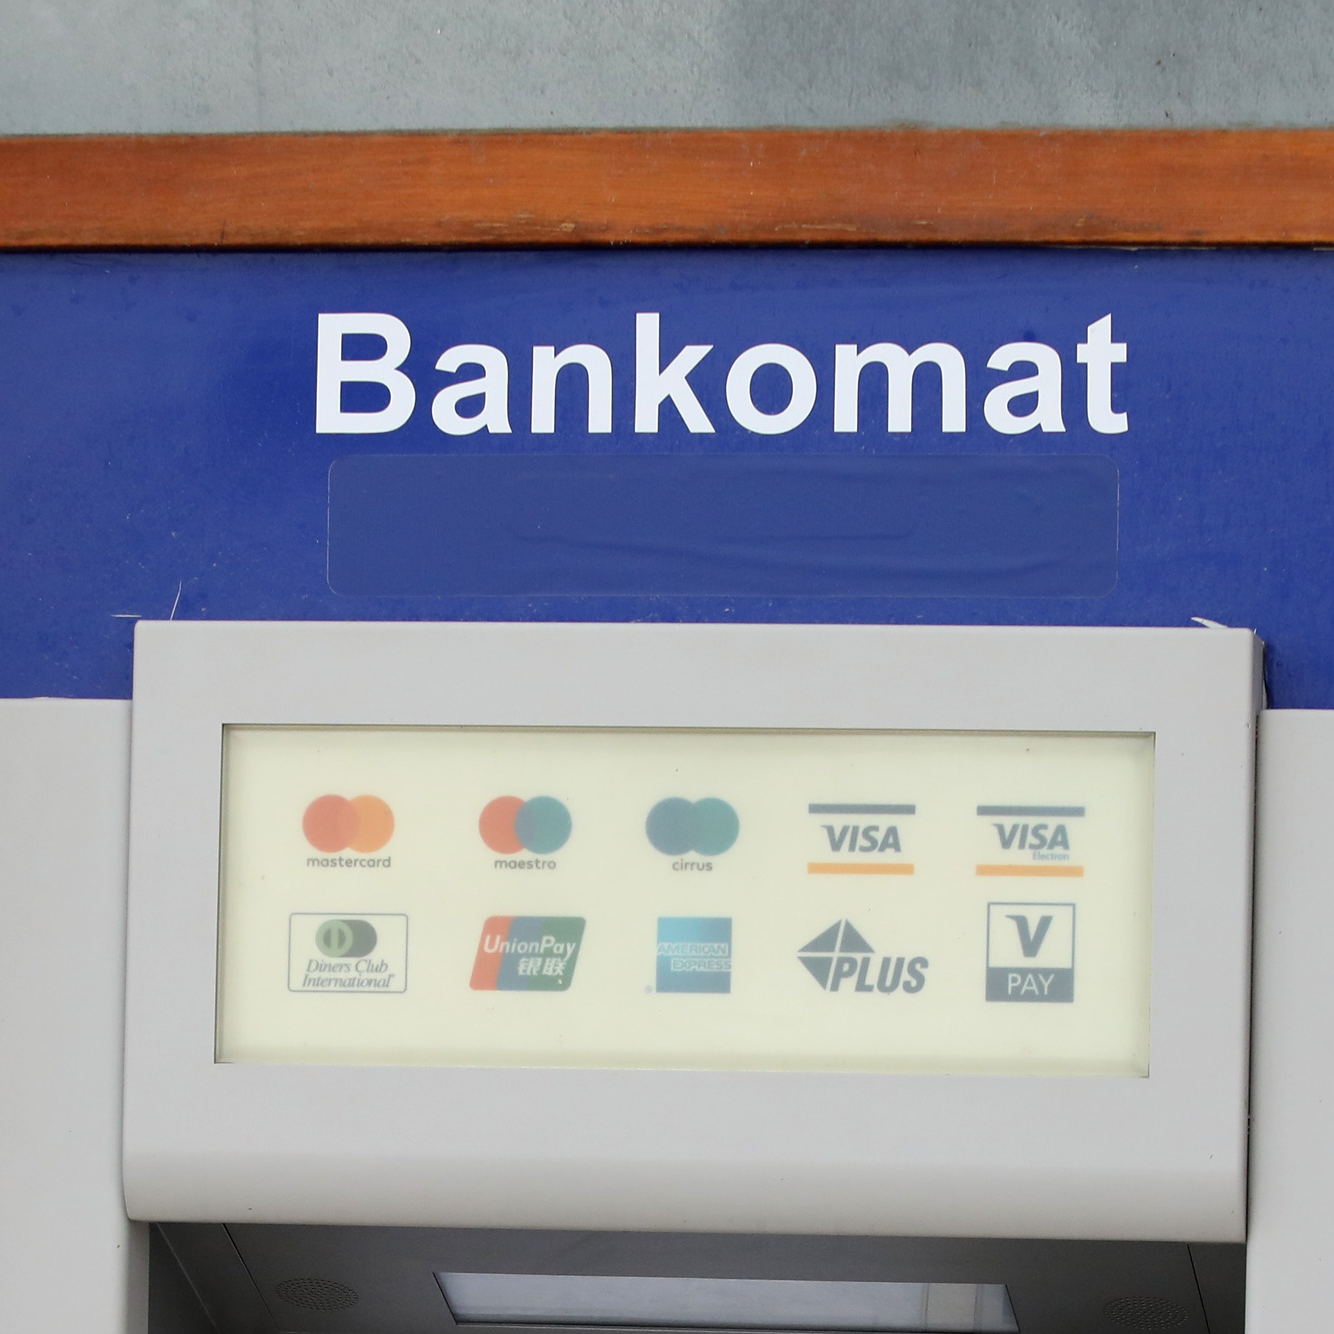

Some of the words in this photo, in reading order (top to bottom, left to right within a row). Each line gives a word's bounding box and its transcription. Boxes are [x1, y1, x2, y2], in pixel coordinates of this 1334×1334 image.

[315, 312, 1130, 436] Bankomat
[820, 825, 902, 853] VISA
[991, 823, 1070, 850] VISA
[306, 856, 392, 869] mastercard
[494, 857, 557, 871] maestro
[1032, 850, 1070, 861] Electron
[671, 859, 713, 872] cirrus
[1005, 915, 1053, 958] V
[483, 934, 576, 961] UnionPay
[657, 942, 729, 956] AMERICAN
[306, 959, 351, 973] Diners
[355, 959, 389, 974] Club
[671, 957, 732, 972] EXPRESS
[829, 956, 929, 994] PLUS
[1007, 974, 1054, 996] PAY
